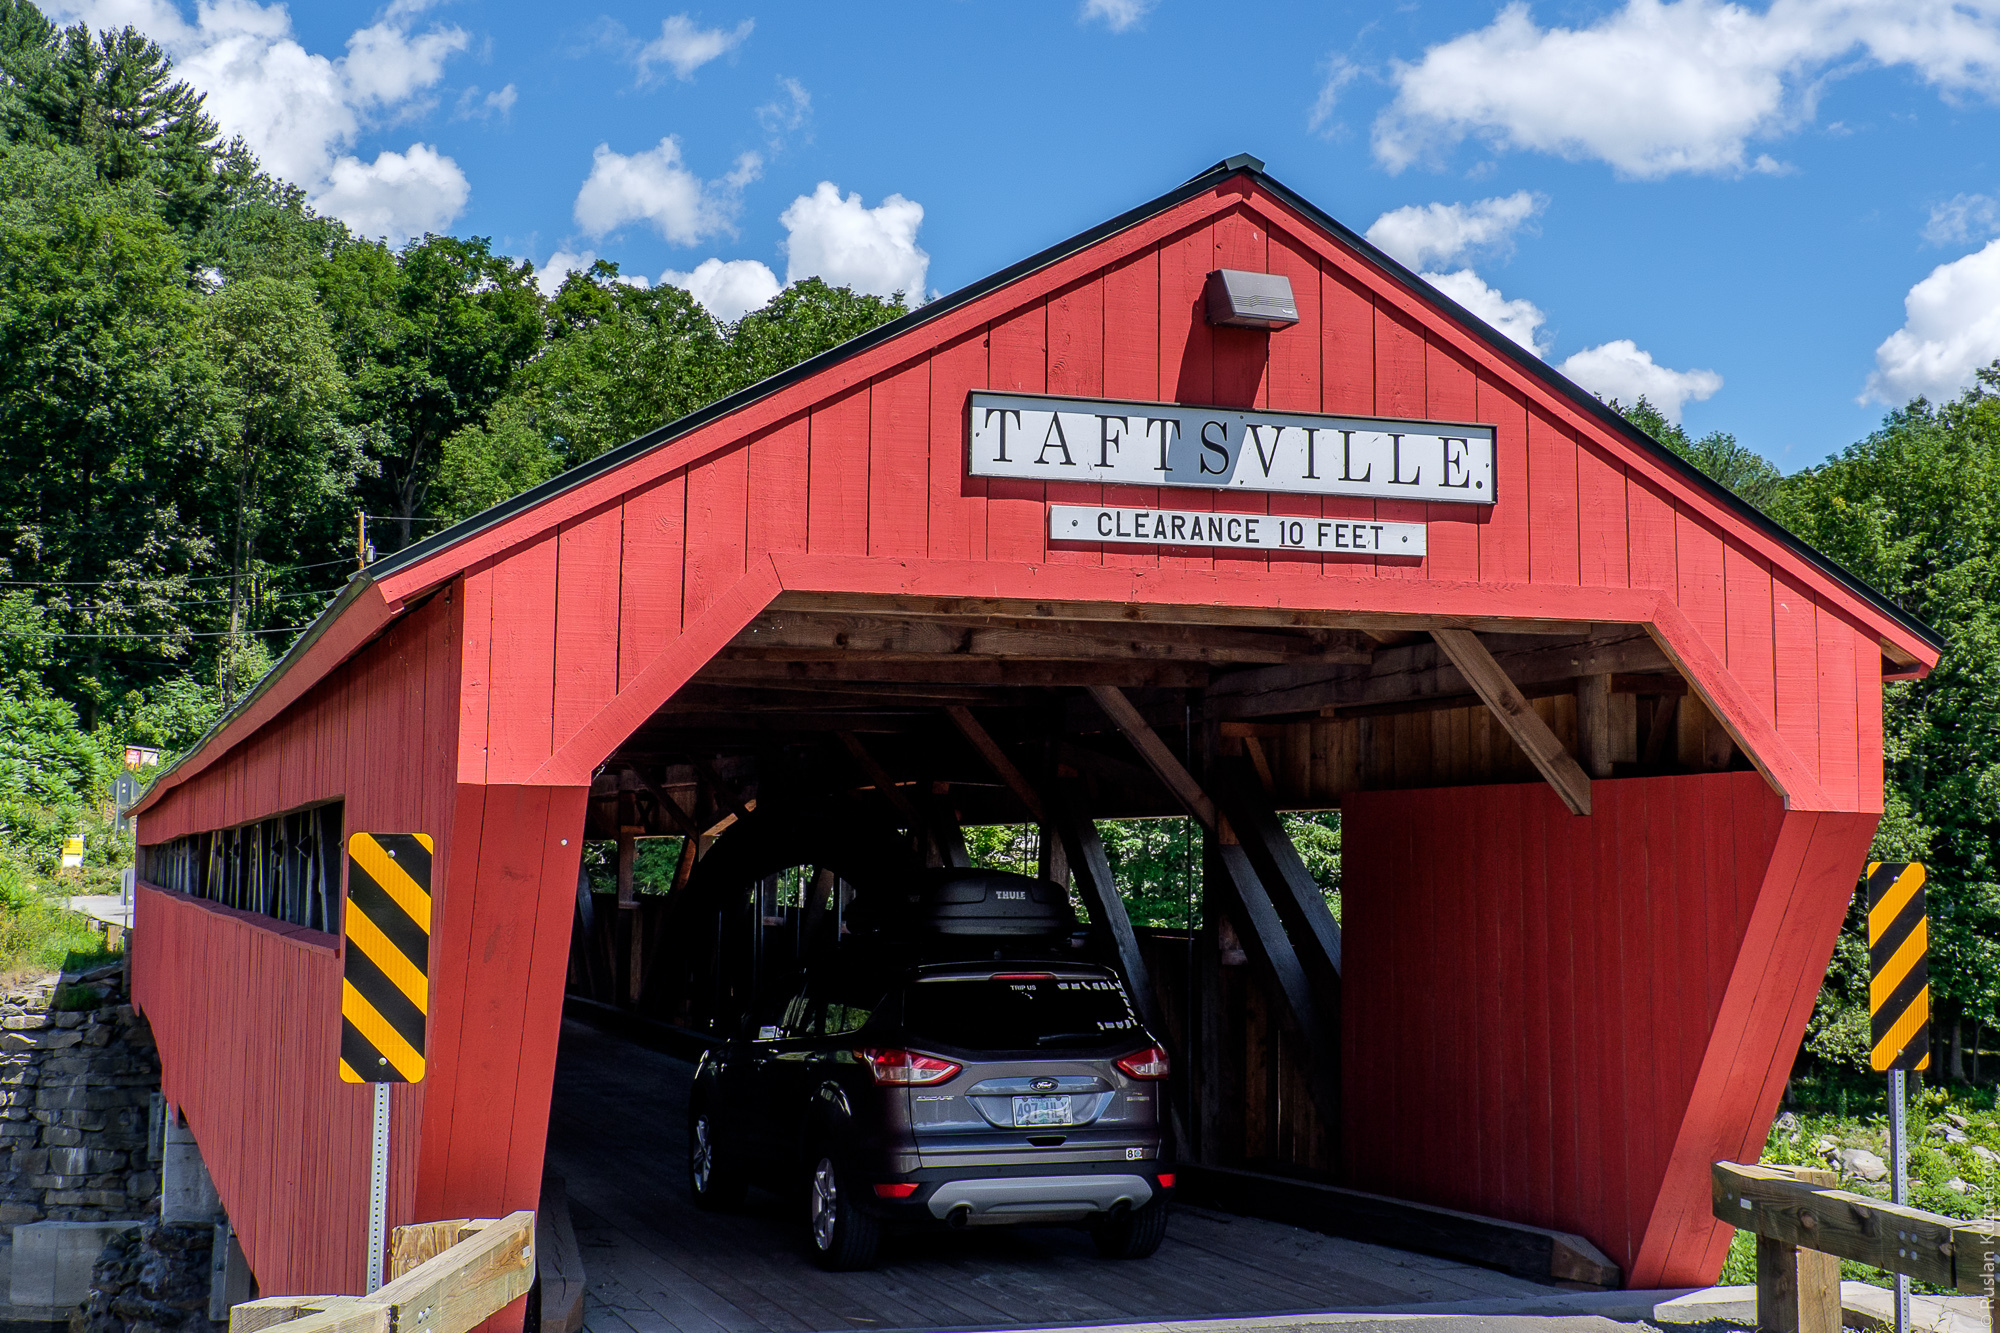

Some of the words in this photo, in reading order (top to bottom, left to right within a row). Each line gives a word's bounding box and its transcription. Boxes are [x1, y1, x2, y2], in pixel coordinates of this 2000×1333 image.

[985, 407, 1483, 490] TAFTSVILLE.
[1097, 511, 1260, 543] CLEARANCE
[1279, 520, 1305, 547] 10
[1317, 523, 1384, 550] FEET
[995, 890, 1026, 900] THULE
